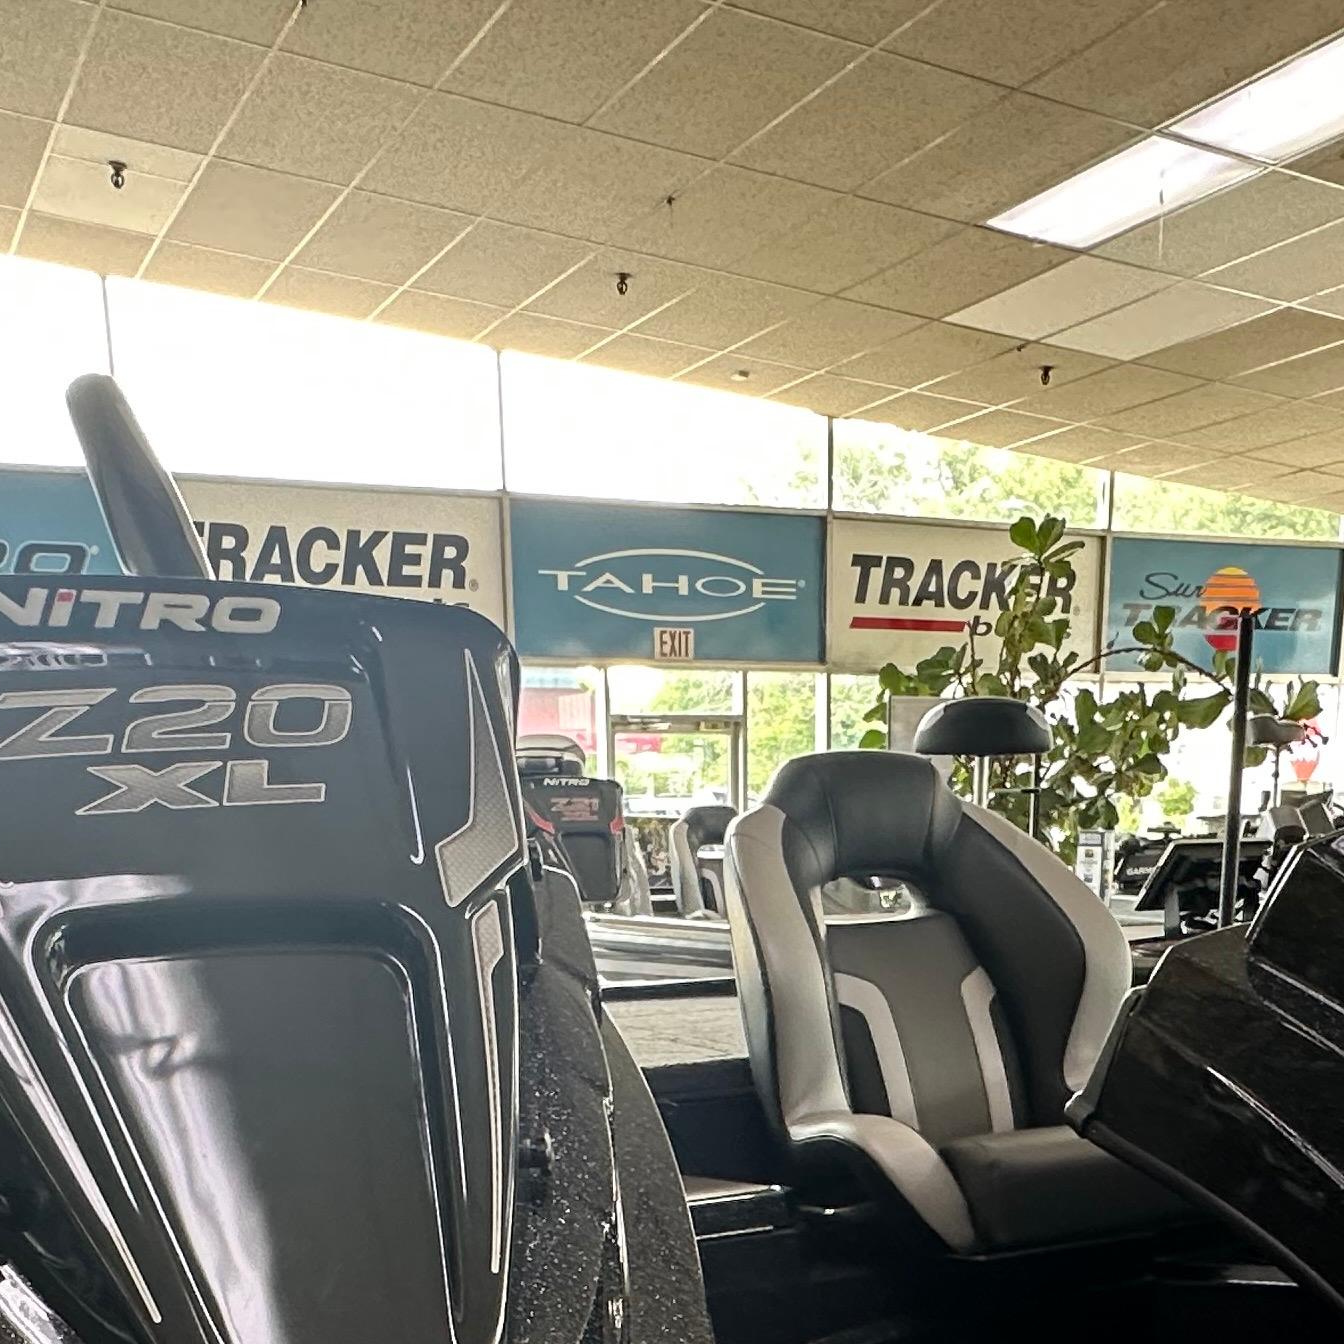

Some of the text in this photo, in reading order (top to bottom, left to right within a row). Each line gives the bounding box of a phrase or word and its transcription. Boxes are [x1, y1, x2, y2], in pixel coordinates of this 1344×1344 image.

[193, 521, 470, 590] RACKER
[538, 569, 797, 600] TAHOE
[658, 629, 692, 658] EXIT
[75, 759, 326, 816] XL
